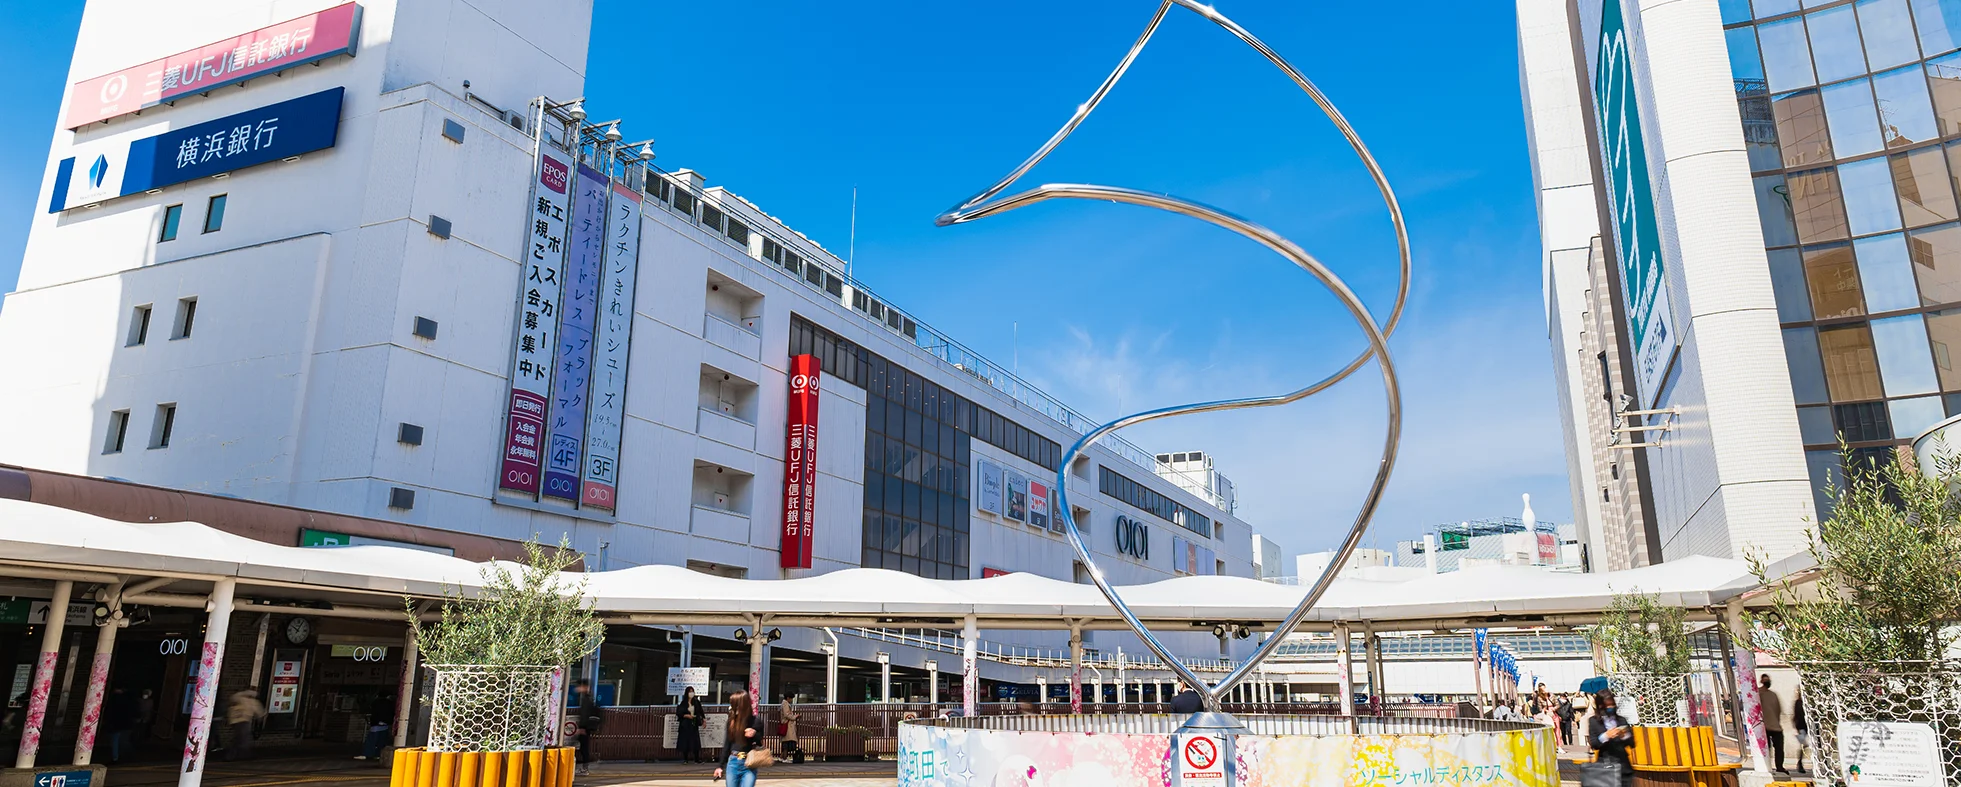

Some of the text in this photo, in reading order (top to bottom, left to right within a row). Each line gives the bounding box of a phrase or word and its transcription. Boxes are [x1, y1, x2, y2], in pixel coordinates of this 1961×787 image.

[141, 27, 311, 97] 三菱UFJ信託銀行
[176, 117, 279, 169] 横浜銀行
[543, 163, 567, 183] EPOS
[545, 175, 563, 188] CARD
[519, 196, 551, 377] 新規ご入会募集中
[535, 205, 564, 381] エポスカード
[601, 204, 631, 409] ラクチンきれいシューズ
[554, 344, 574, 429] フォーマル
[572, 338, 589, 408] ブラック
[515, 421, 537, 434] 入会金
[554, 449, 575, 467] 4F
[592, 459, 611, 477] 3F
[786, 424, 802, 536] 三菱UFJ信託銀行
[803, 424, 816, 537] 三菱UFJ信託銀行
[1361, 764, 1505, 785] ソーシャルディスタンス
